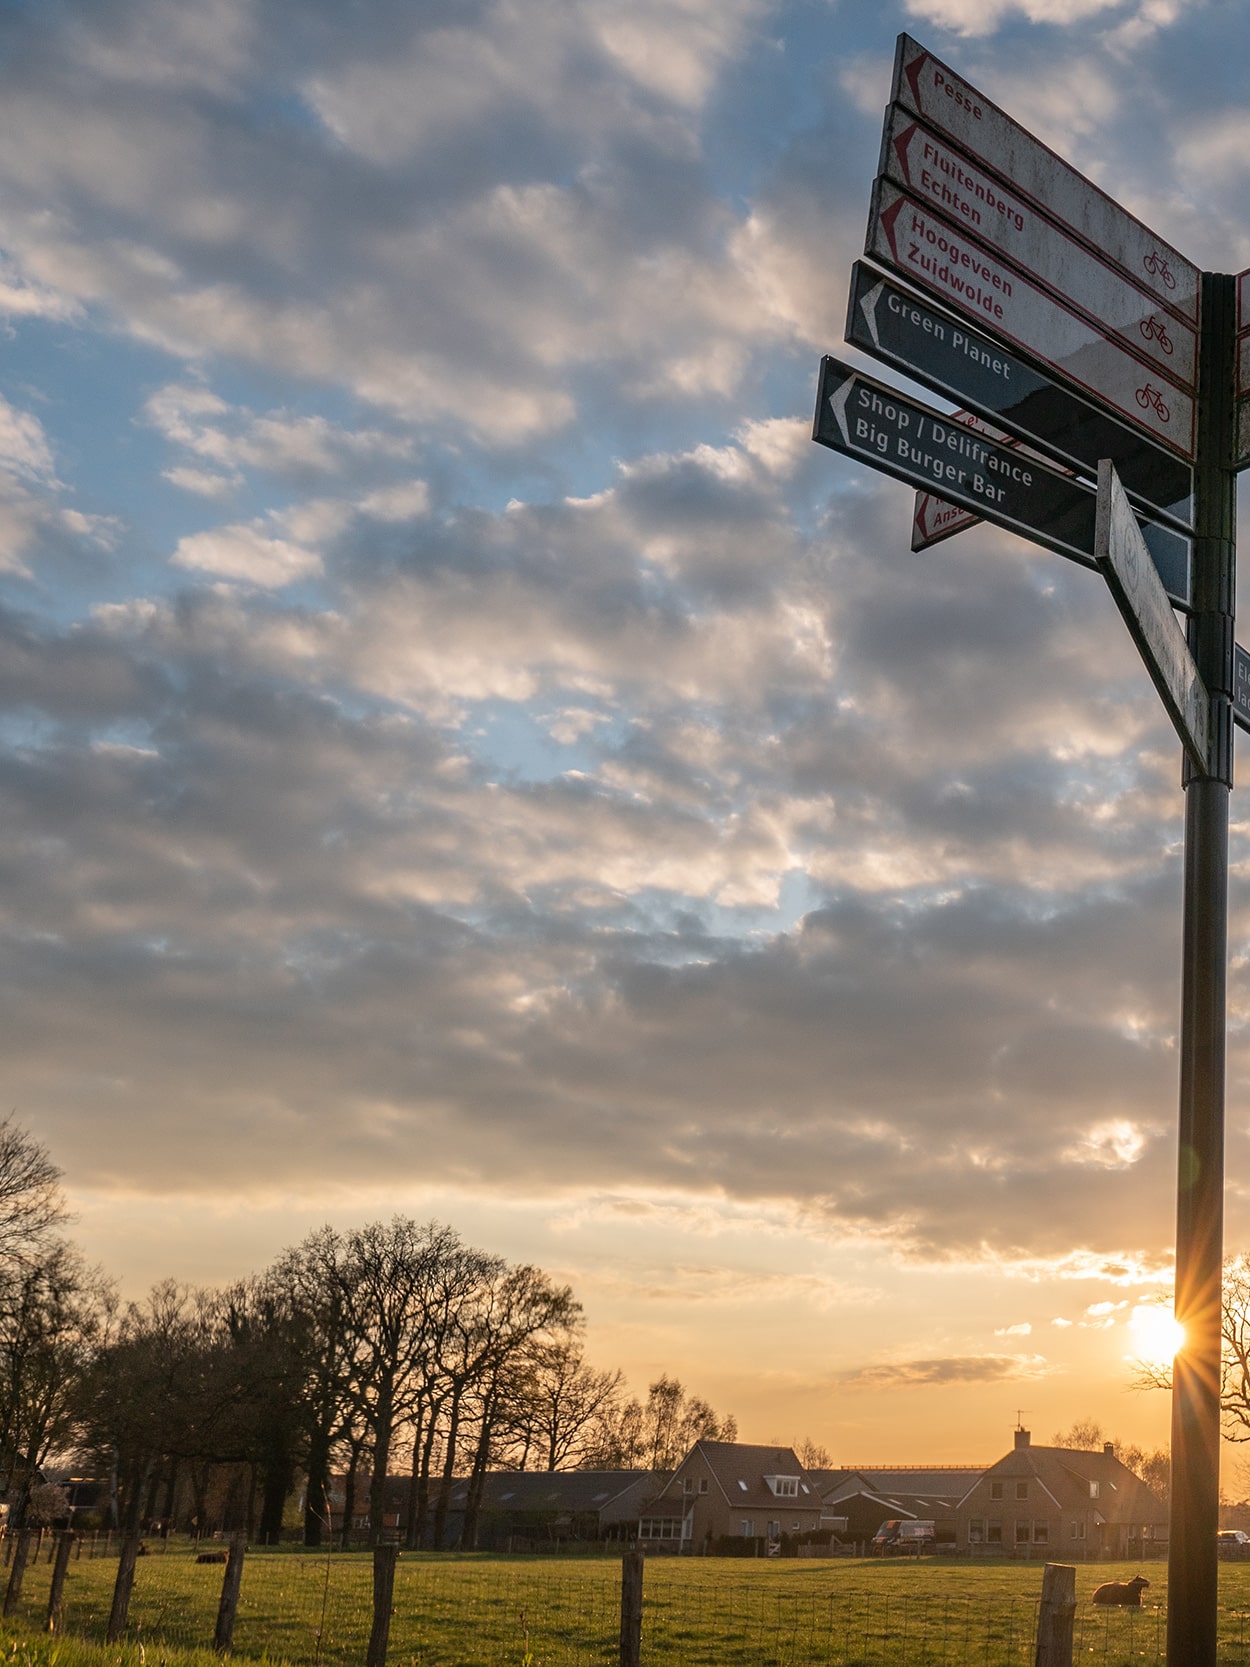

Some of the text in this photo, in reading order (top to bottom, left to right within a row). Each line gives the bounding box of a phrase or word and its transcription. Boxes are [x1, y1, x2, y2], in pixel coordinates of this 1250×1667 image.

[934, 70, 982, 120] Pesse
[921, 168, 981, 225] Echten
[923, 142, 1024, 232] Fluitenberg
[908, 242, 1004, 319] Zuidwolde
[912, 215, 1013, 297] Hoogeveen
[888, 294, 1010, 380] Green Planet
[856, 418, 1006, 503] Big Burger Bar
[858, 388, 1033, 487] Shop / Délifrance
